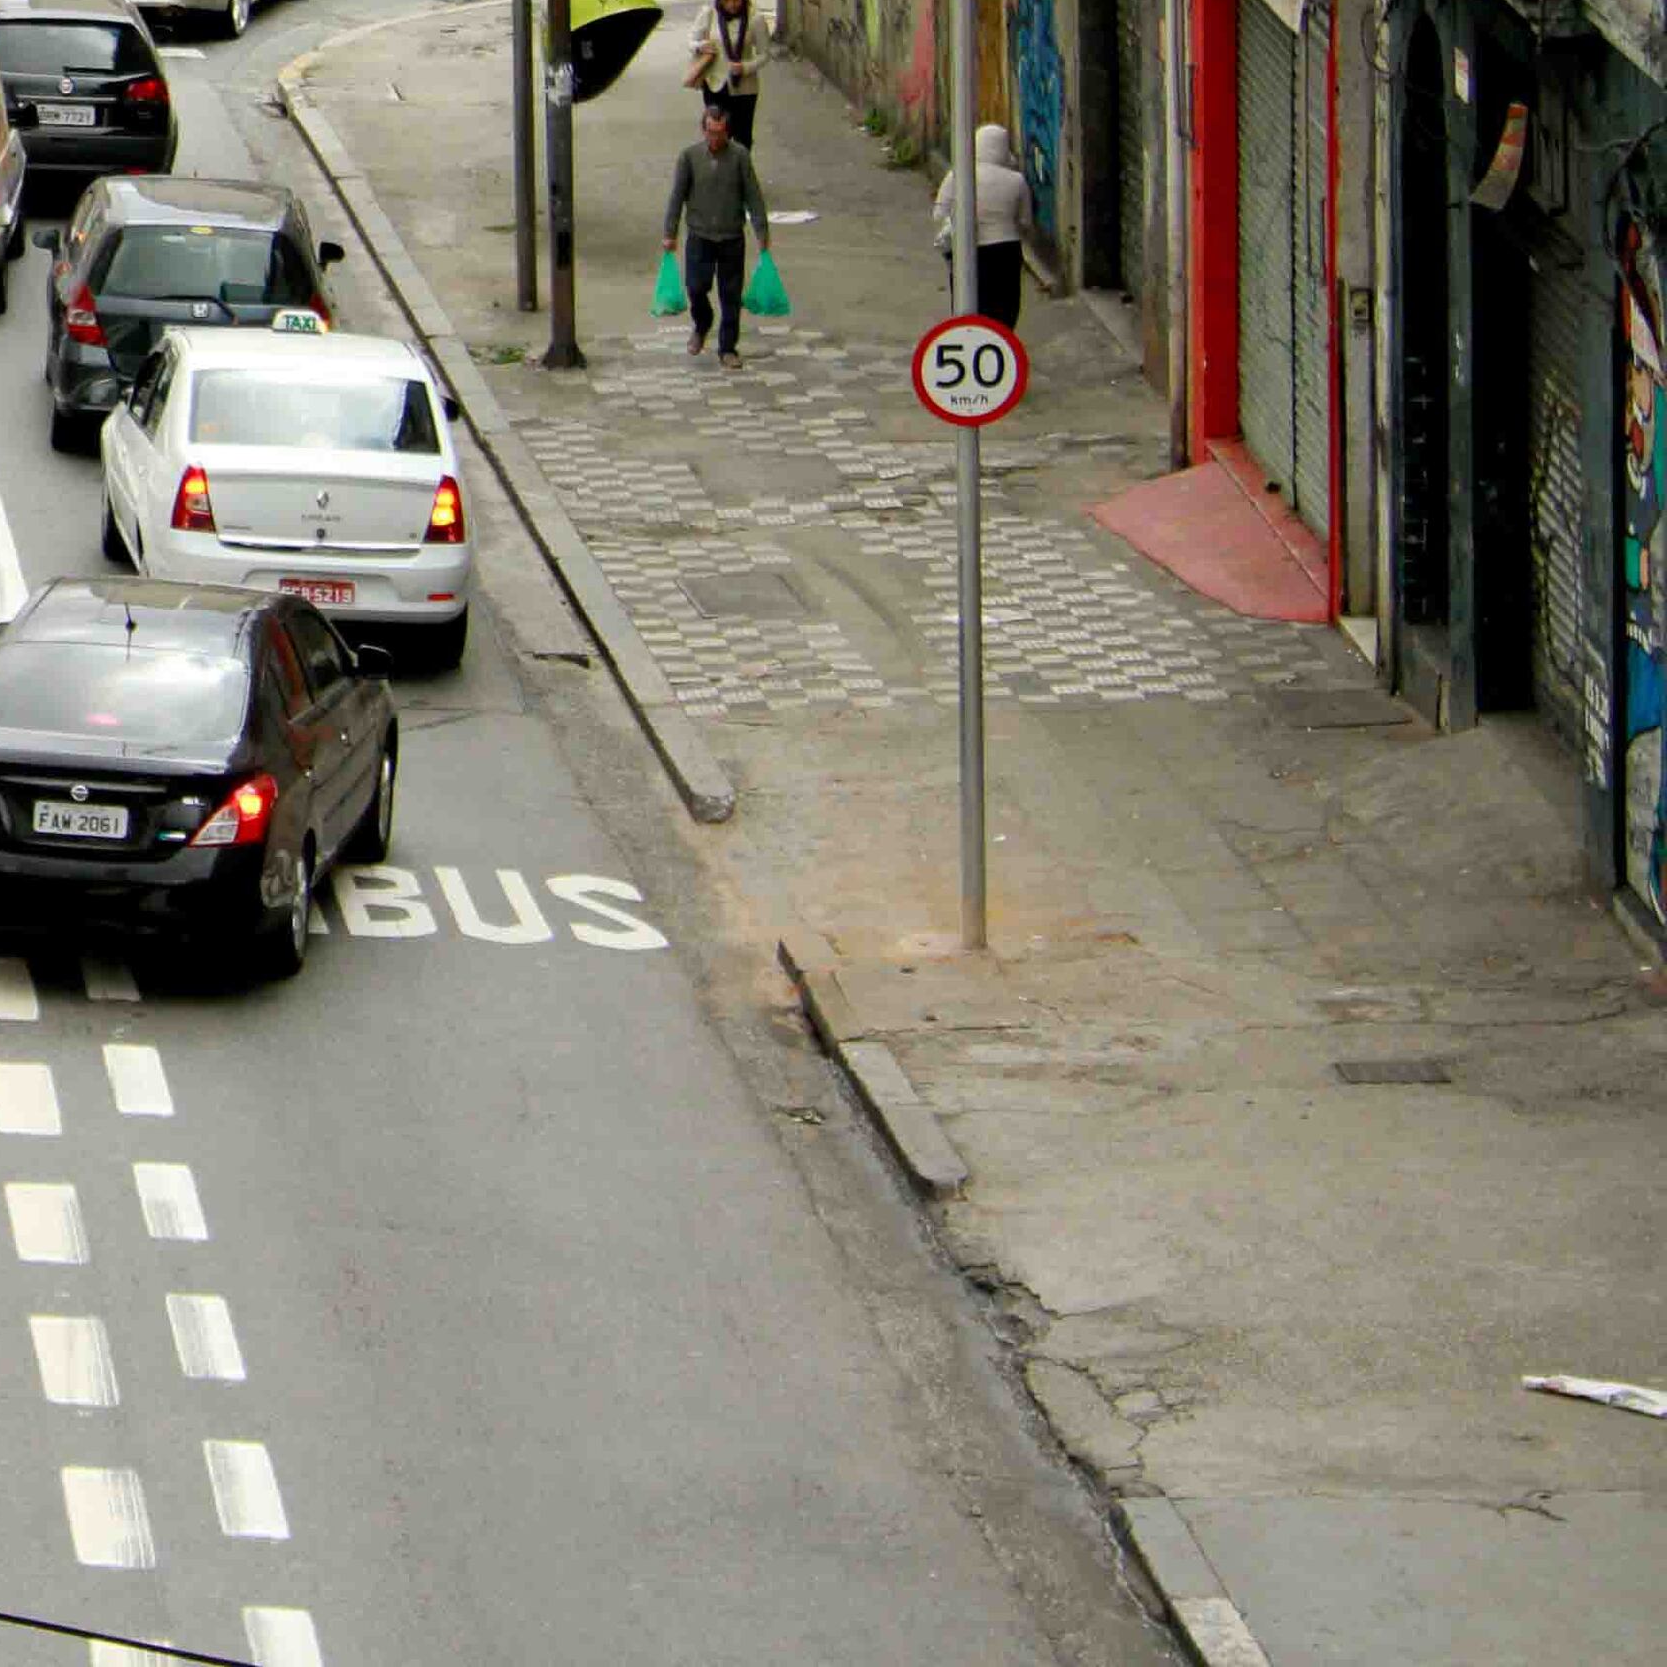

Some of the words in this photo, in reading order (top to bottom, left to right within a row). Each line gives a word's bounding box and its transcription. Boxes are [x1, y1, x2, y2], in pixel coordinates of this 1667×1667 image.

[283, 313, 318, 332] TAXI
[936, 343, 1005, 388] 50
[949, 394, 989, 406] km/h
